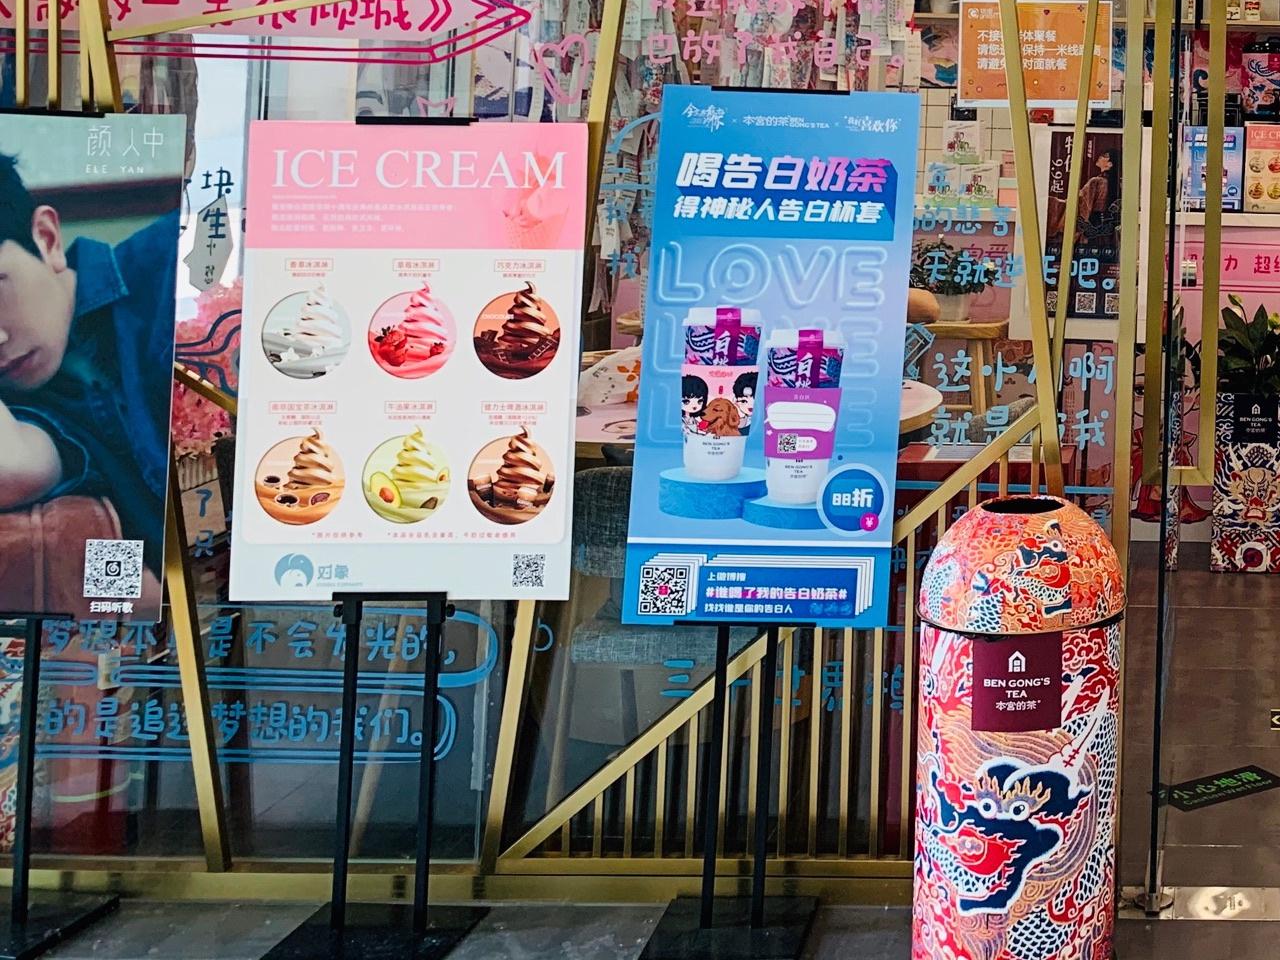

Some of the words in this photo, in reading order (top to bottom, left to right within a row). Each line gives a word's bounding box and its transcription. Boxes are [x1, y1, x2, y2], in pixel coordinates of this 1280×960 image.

[977, 29, 1057, 42] 不接体聚餐
[977, 43, 1101, 57] 请您保持一米线
[977, 58, 1068, 71] 请避对面就餐
[120, 165, 145, 174] YAN
[271, 148, 360, 188] ICE
[375, 149, 568, 190] CREAM
[676, 152, 892, 193] 喝告白奶茶
[673, 194, 885, 225] 得神秘人告白杯套
[658, 239, 888, 307] LOVE
[932, 349, 1116, 395] 这小啊
[927, 404, 1110, 451] 就是我
[832, 488, 874, 508] 88折
[42, 617, 457, 665] 梦想本是不会发光的，
[983, 678, 1007, 688] BEN
[1008, 677, 1051, 688] GONG'S
[1005, 690, 1028, 698] TEA
